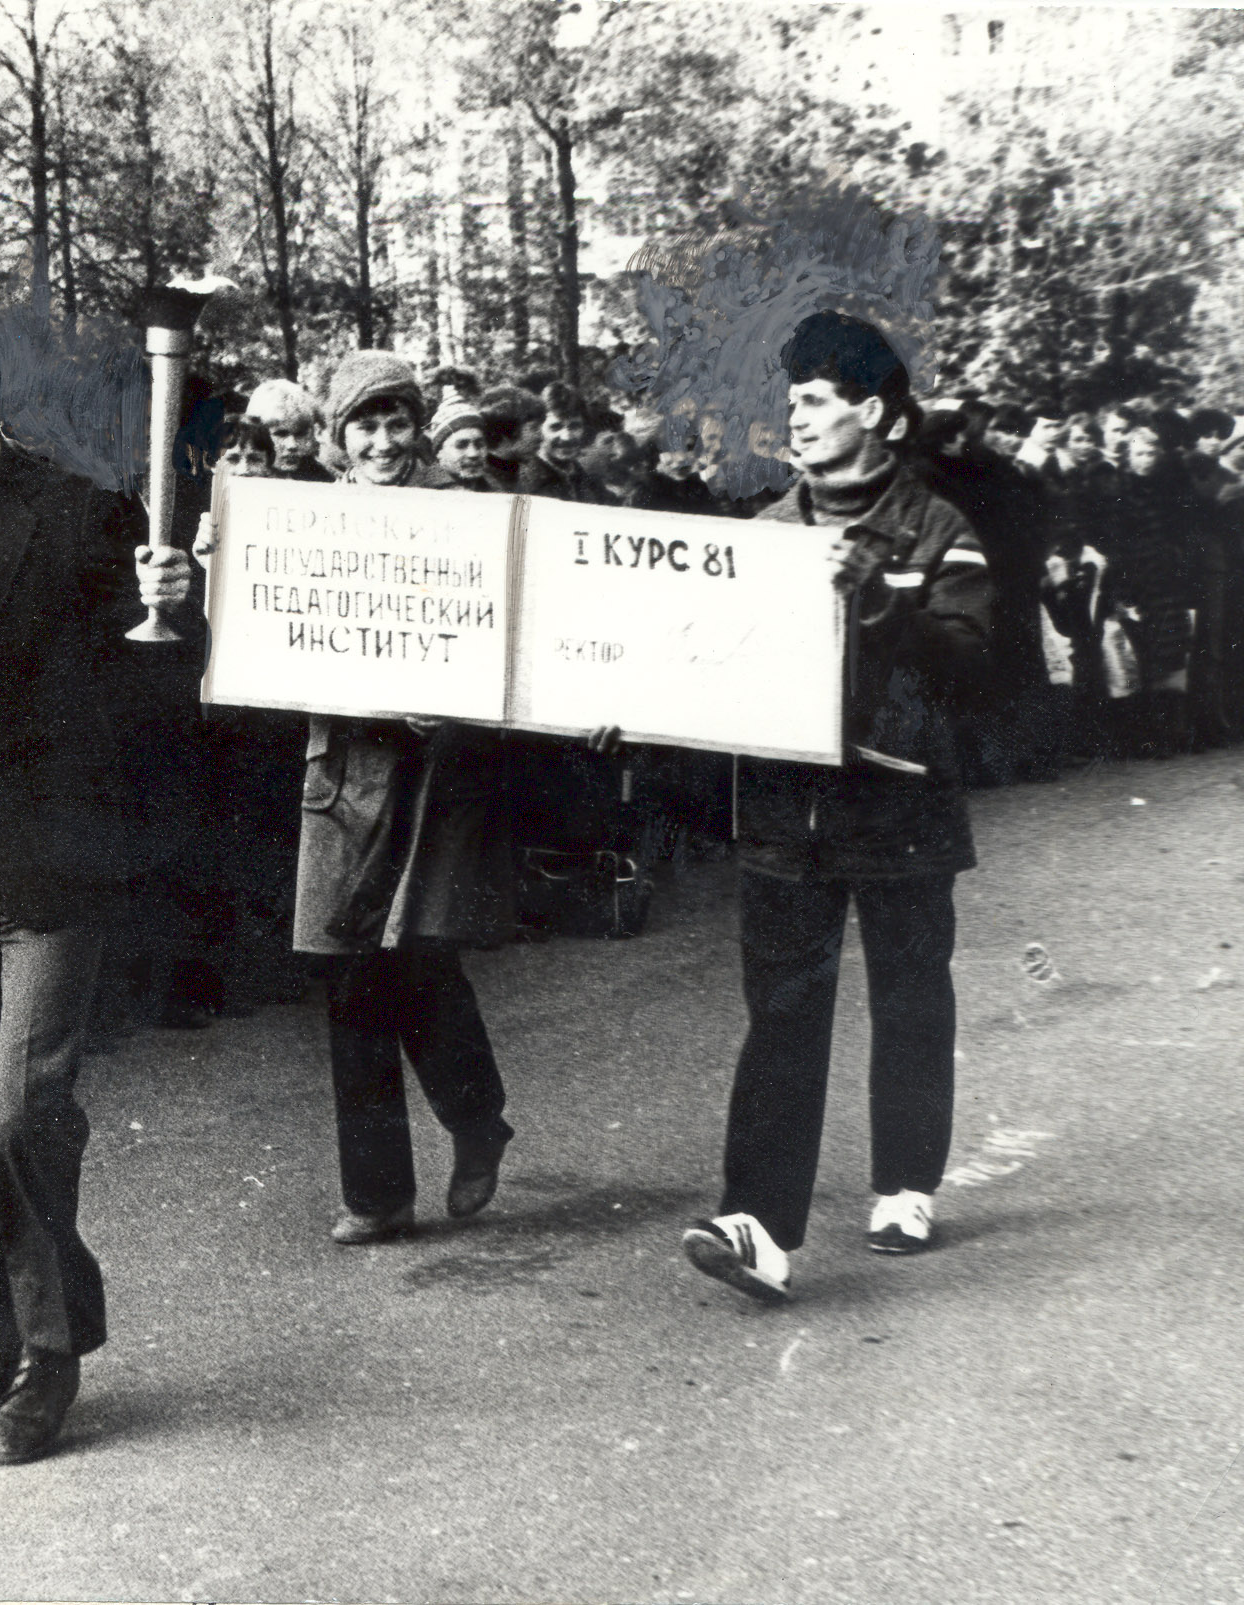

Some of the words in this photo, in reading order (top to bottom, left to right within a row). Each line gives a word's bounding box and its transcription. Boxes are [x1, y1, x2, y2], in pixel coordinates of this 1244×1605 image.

[245, 544, 483, 589] ГОСУДАРСТВЕННЫЙ
[603, 533, 690, 572] КУРС
[702, 543, 736, 579] 81
[252, 583, 494, 629] ПЕДАГОГИЧЕСКИЙ
[288, 621, 459, 663] ИНСТИТУТ
[555, 637, 625, 664] РЕКТОР
